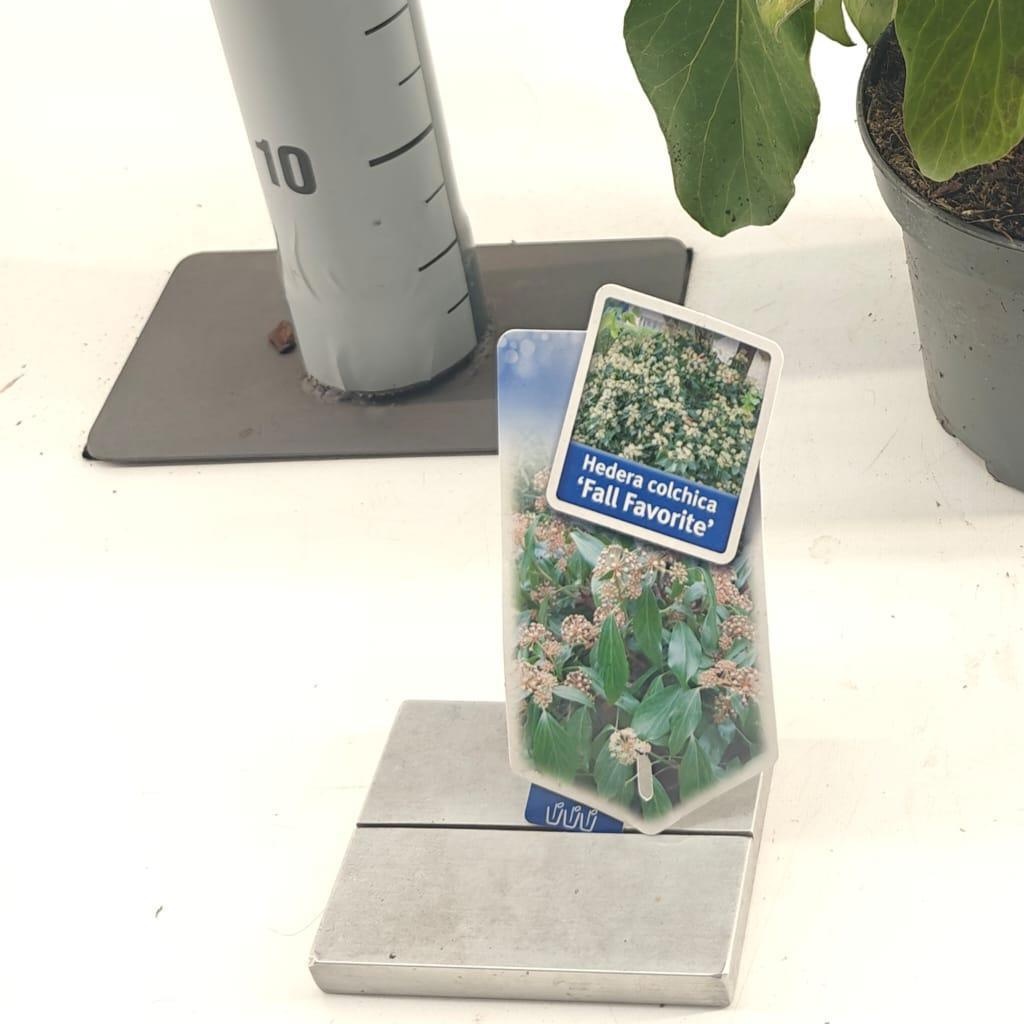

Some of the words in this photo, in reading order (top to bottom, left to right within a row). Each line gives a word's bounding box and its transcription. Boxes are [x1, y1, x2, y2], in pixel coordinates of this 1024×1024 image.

[255, 139, 317, 195] 10
[577, 476, 618, 508] ‘Fall
[622, 492, 714, 537] Favorite’
[582, 454, 644, 489] Hedera
[647, 479, 718, 513] colchica
